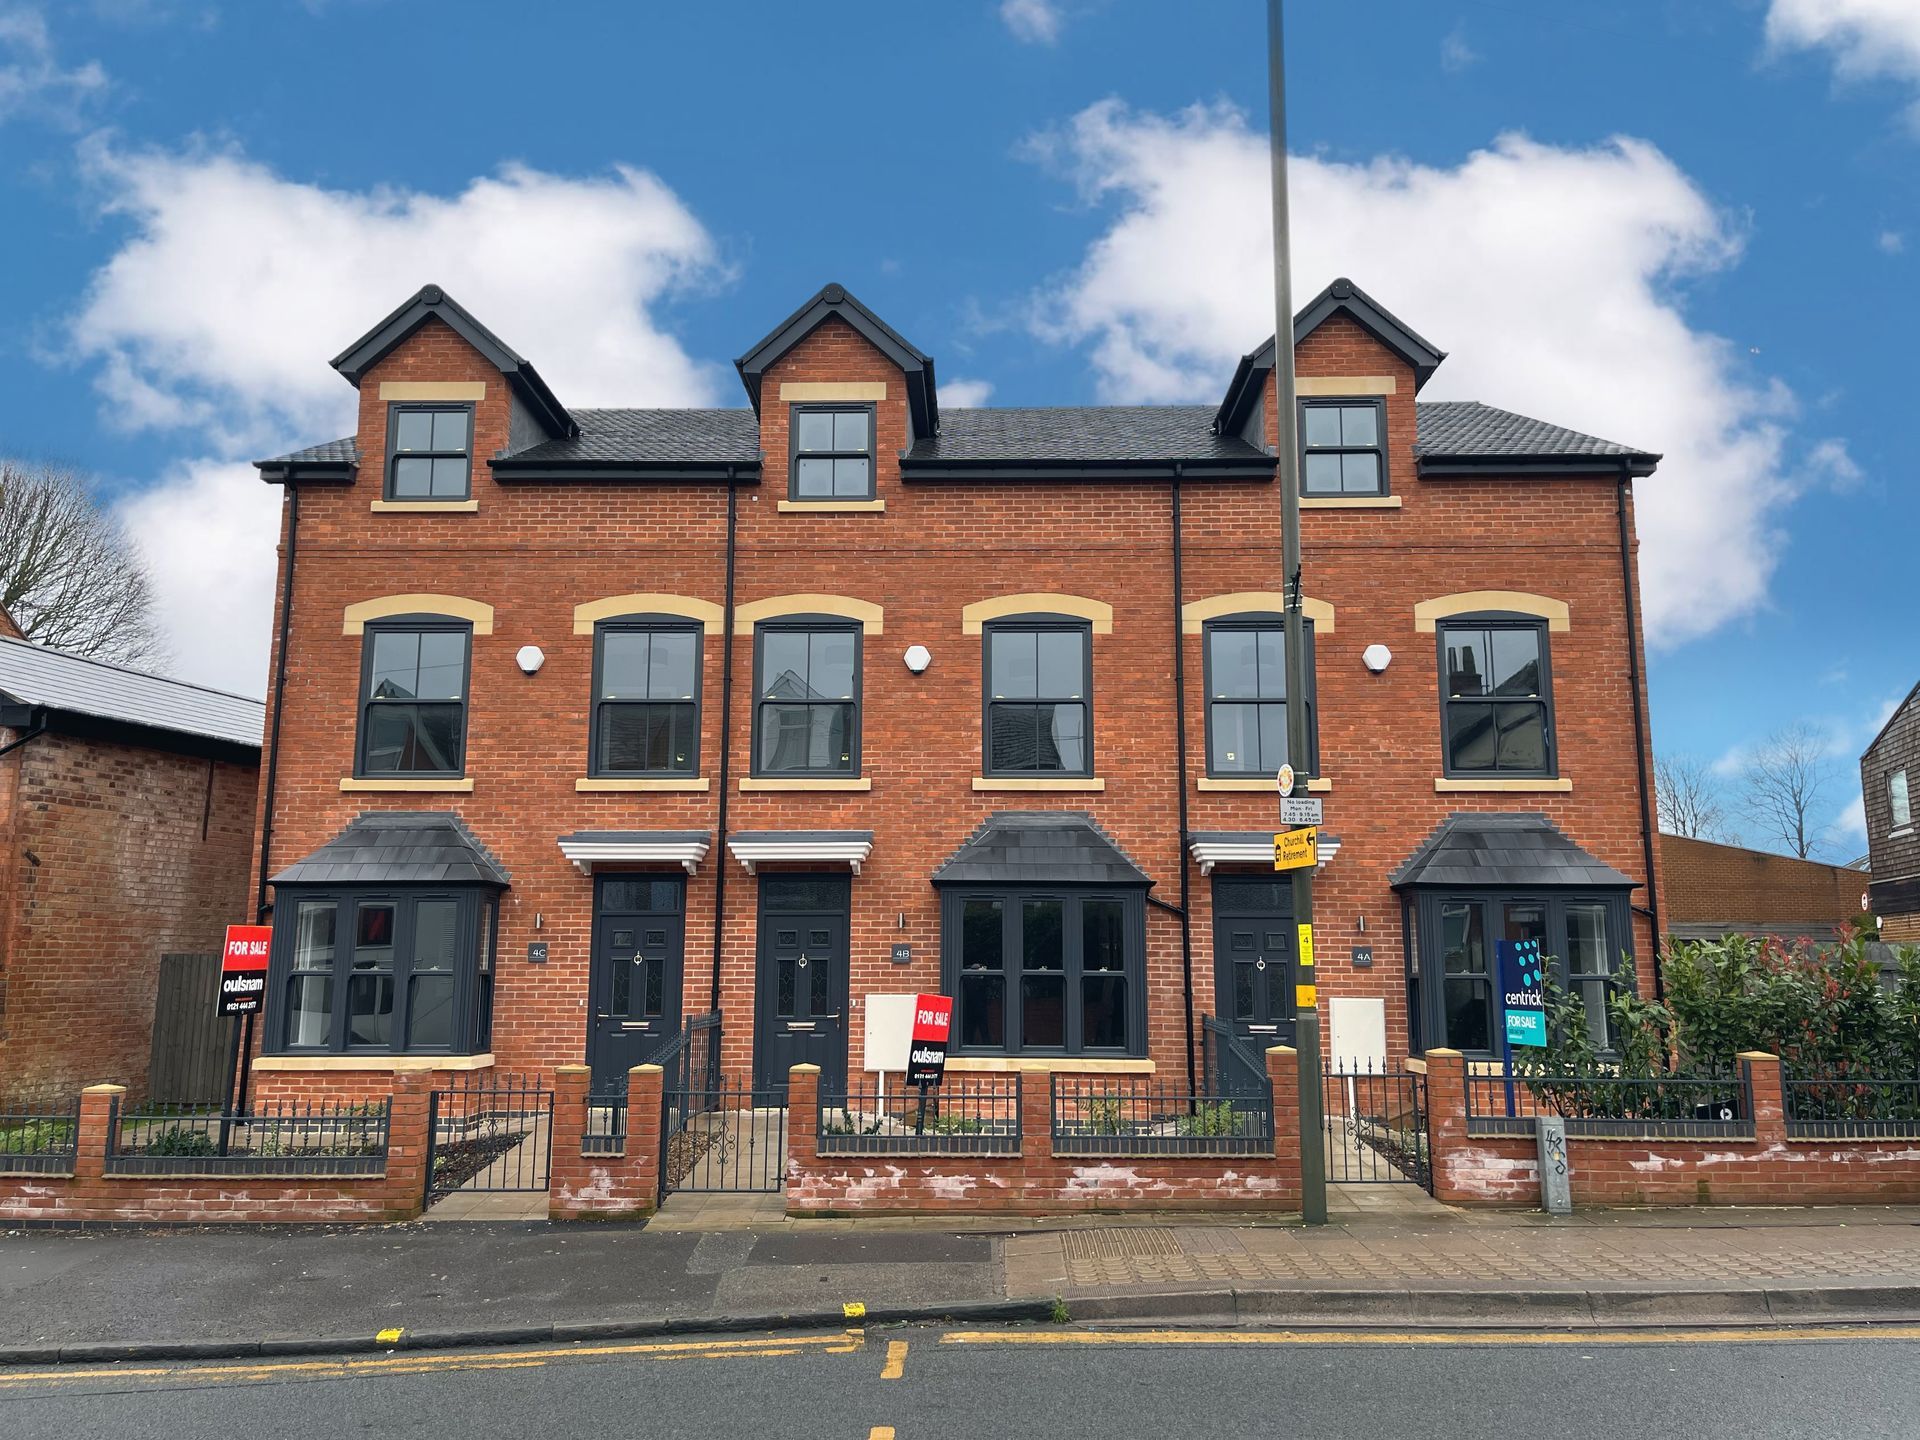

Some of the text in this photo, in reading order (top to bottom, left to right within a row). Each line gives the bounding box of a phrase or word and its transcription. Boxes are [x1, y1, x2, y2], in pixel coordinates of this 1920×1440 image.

[1282, 848, 1308, 861] Retirement
[228, 941, 268, 955] FOR SALE
[224, 975, 264, 992] oulsnam
[1505, 989, 1542, 1006] centrick
[918, 1010, 948, 1027] FOR SALE
[1507, 1015, 1536, 1029] FOR SALE
[912, 1046, 944, 1064] oulsnam
